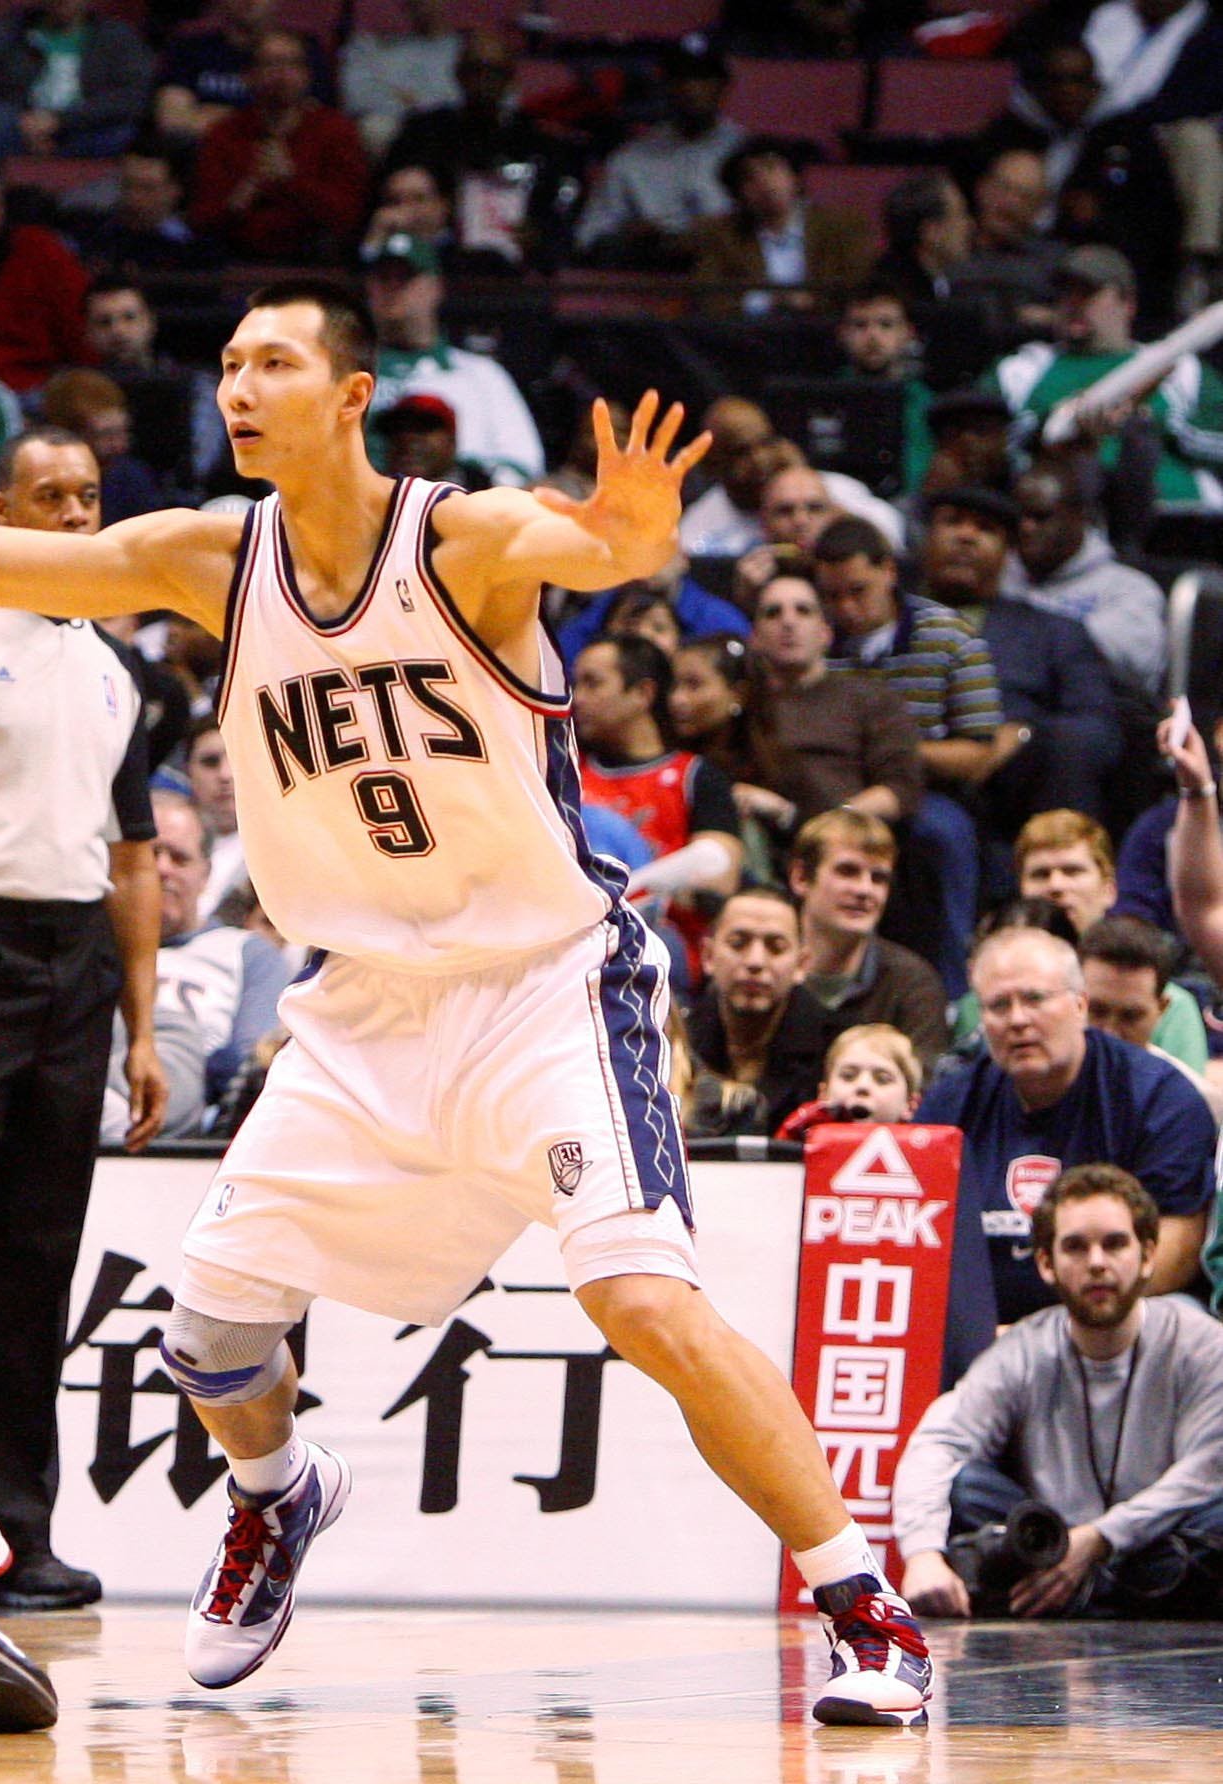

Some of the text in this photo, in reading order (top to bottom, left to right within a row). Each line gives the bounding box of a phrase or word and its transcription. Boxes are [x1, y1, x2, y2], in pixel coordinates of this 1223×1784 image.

[255, 658, 490, 797] NETS
[350, 769, 437, 859] 9
[803, 1195, 949, 1249] PEAK
